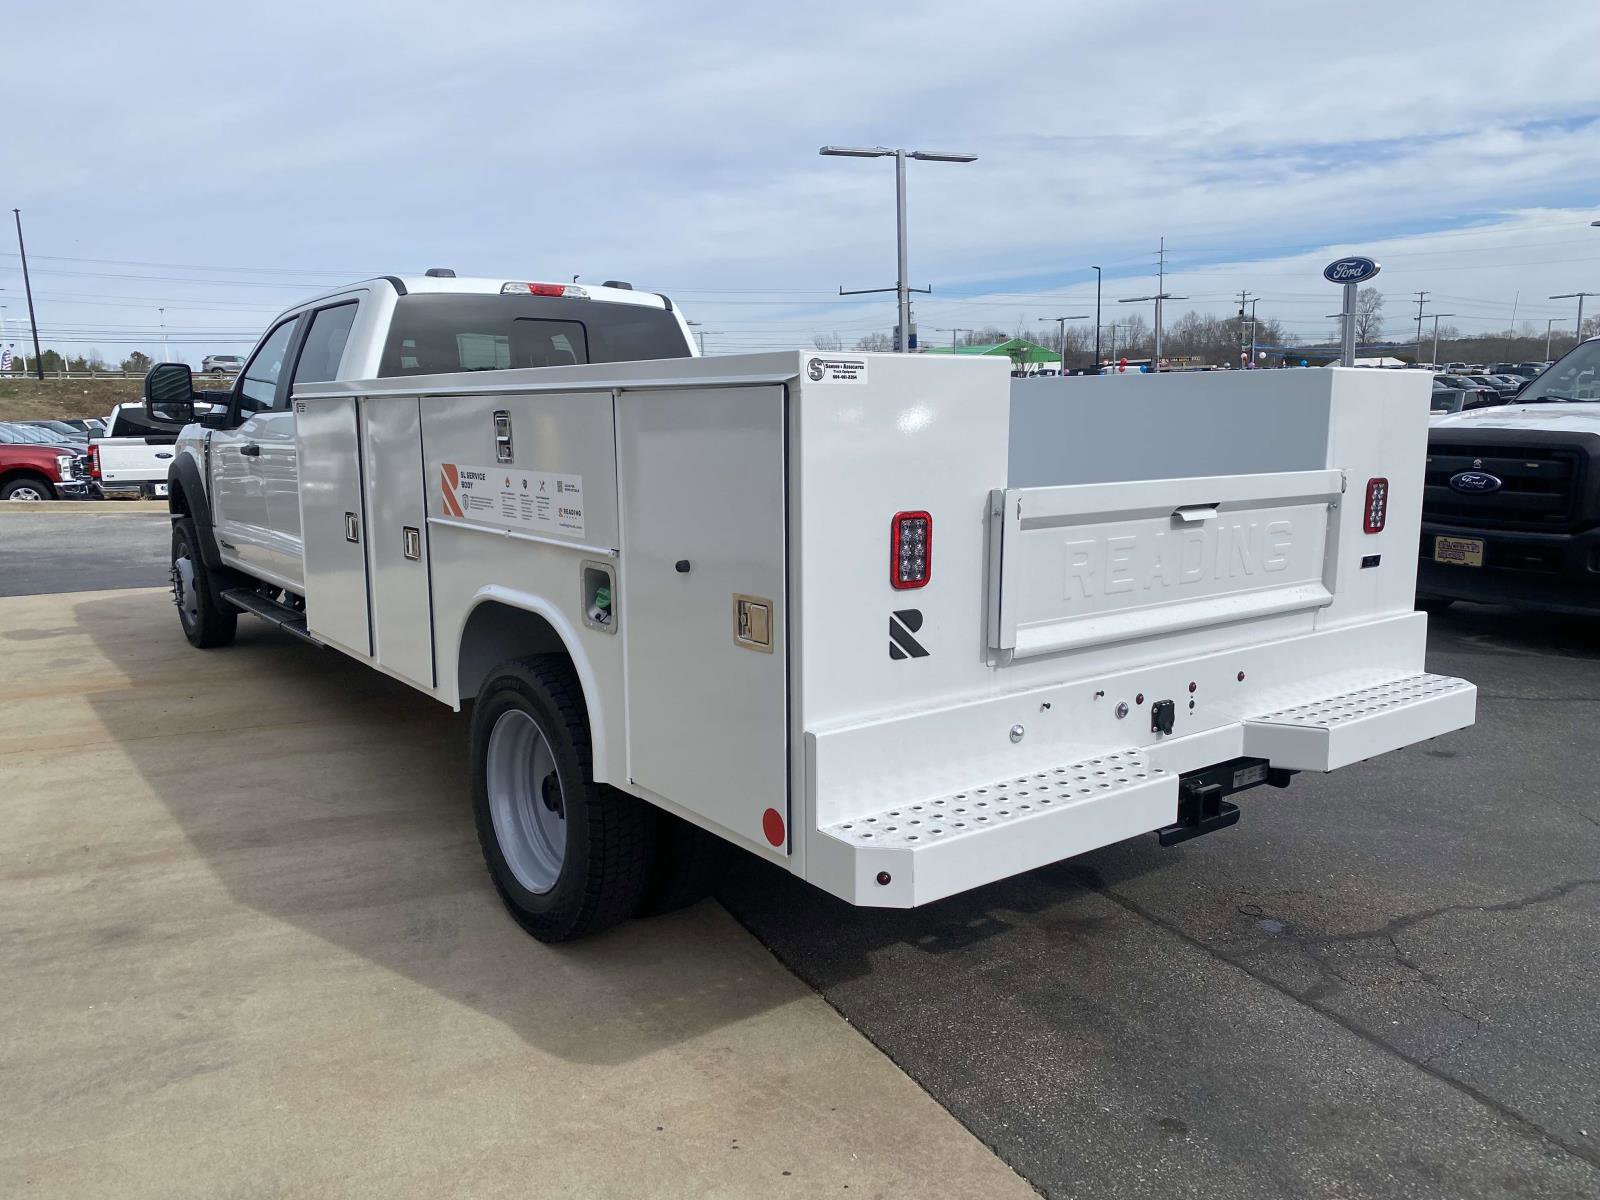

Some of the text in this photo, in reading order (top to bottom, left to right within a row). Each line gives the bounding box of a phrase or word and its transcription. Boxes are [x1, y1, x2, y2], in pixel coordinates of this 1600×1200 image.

[1333, 261, 1364, 279] Ford
[460, 471, 486, 481] SL SERVICE
[1459, 474, 1487, 489] Ford
[461, 480, 473, 489] BODY
[563, 508, 582, 517] READING
[1062, 519, 1293, 602] READING
